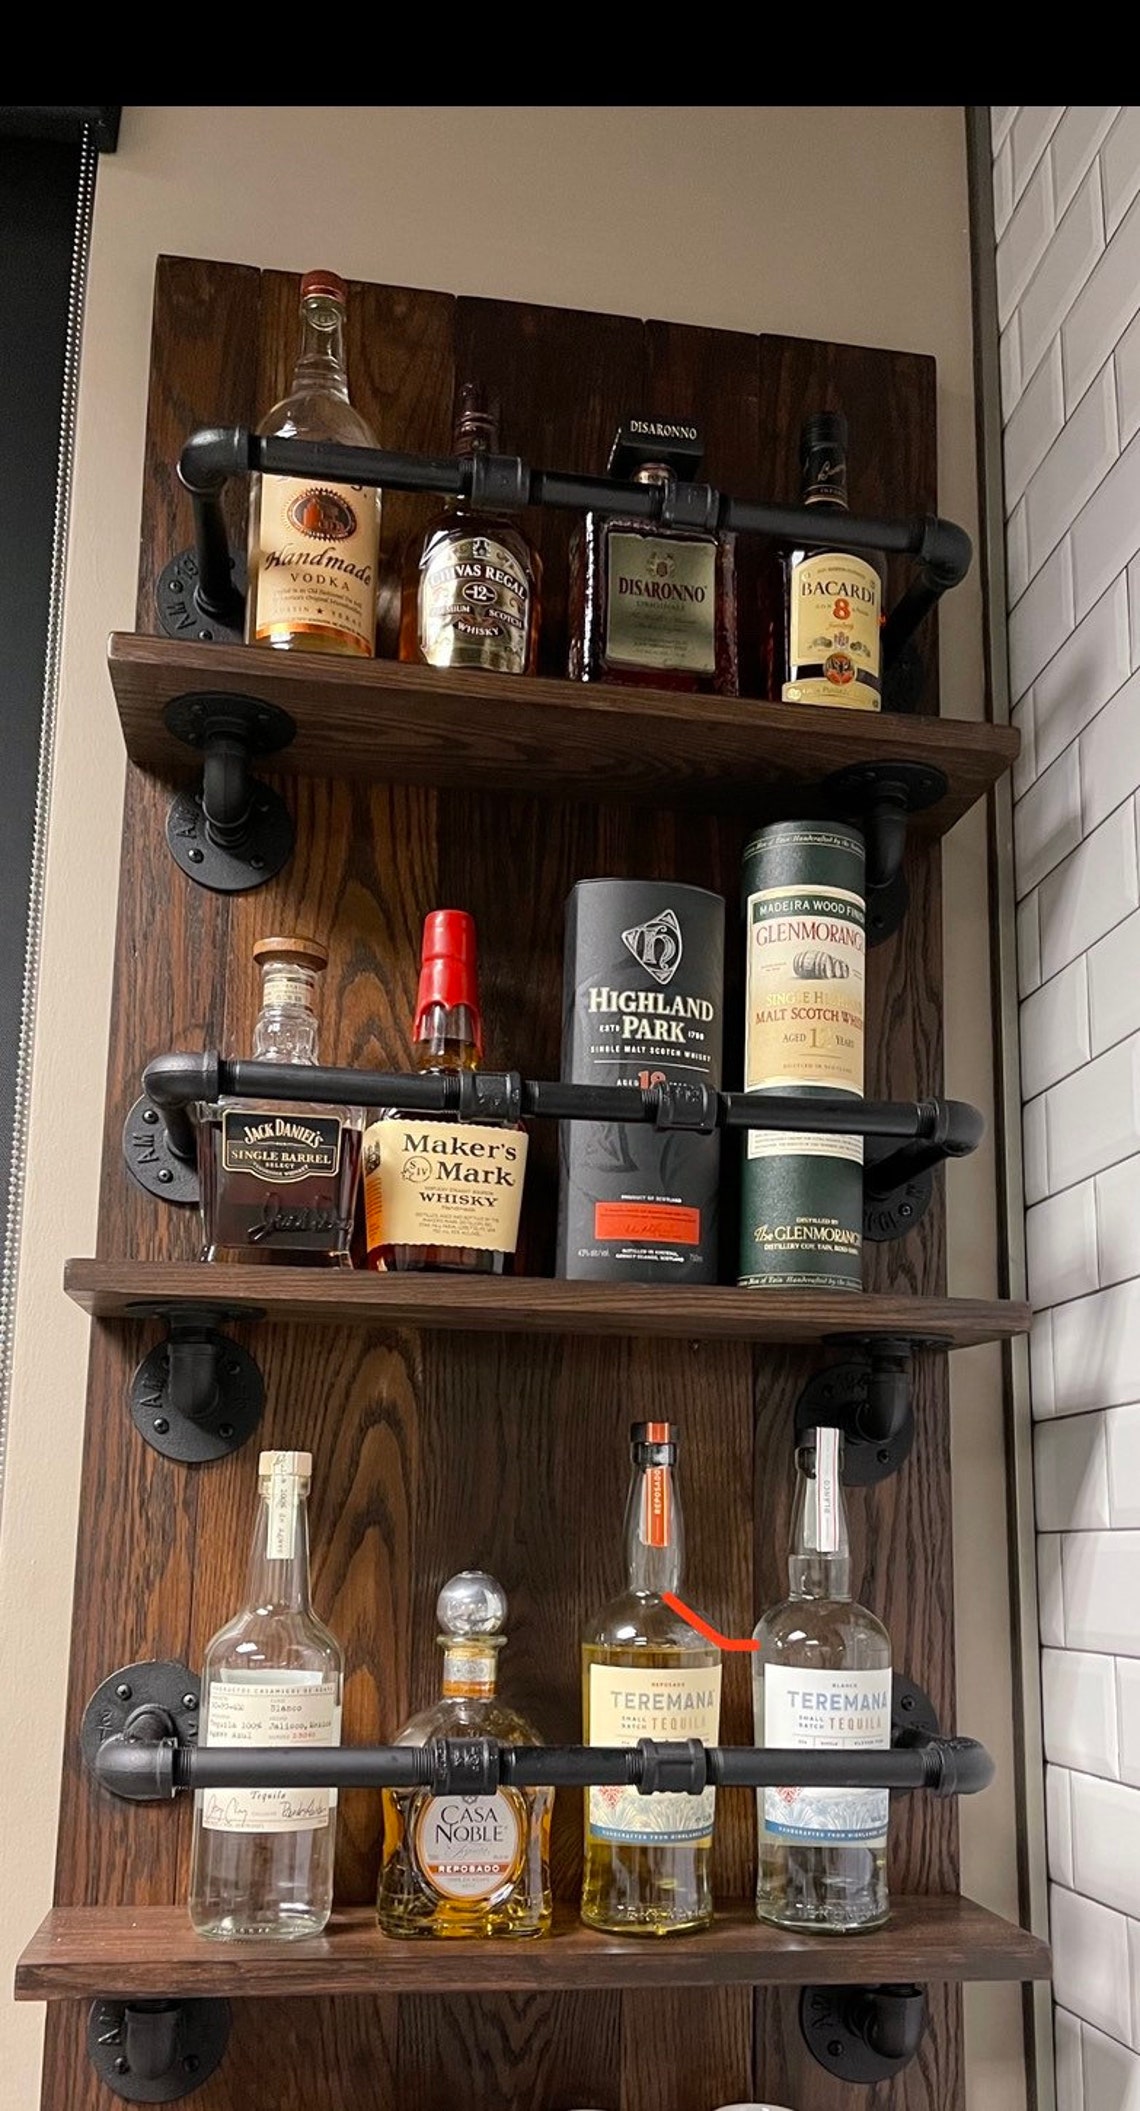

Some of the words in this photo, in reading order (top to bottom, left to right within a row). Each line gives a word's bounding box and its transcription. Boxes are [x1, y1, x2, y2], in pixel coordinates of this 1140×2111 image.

[630, 420, 697, 440] DISARONNO
[265, 543, 371, 585] Handmade
[290, 573, 351, 591] VODKA
[485, 566, 525, 599] REGAL
[619, 577, 706, 603] DISARONNO
[472, 585, 487, 600] 12
[802, 581, 875, 605] BACARDI
[833, 598, 851, 620] 8
[489, 609, 522, 629] SCOTCH
[458, 621, 499, 636] WHISKY
[760, 900, 810, 915] MADEIRA
[813, 901, 845, 913] WOOD
[588, 987, 714, 1022] HIGHLAND
[756, 1009, 787, 1024] MALT
[791, 1007, 839, 1022] SCOTCH
[622, 1015, 686, 1043] PARK
[782, 1033, 807, 1043] AGED
[624, 1045, 646, 1053] MALT
[650, 1047, 680, 1057] SCOTCH
[243, 1122, 275, 1144] JACK
[275, 1118, 324, 1148] DANIEL'S
[231, 1149, 279, 1161] SINGLE
[281, 1152, 332, 1164] BARREL
[402, 1134, 517, 1161] Maker's
[265, 1161, 295, 1169] SELECT
[435, 1161, 515, 1187] Mark
[419, 1192, 499, 1208] WHISKY
[796, 1217, 830, 1225] DISTILLED
[754, 1223, 774, 1242] The
[610, 1690, 714, 1711] TEREMANA
[787, 1690, 888, 1711] TEREMANA
[622, 1715, 646, 1723] SMALL
[651, 1715, 707, 1731] TEQUILA
[799, 1714, 824, 1723] SMALL
[799, 1722, 824, 1730] BATCH
[829, 1715, 882, 1731] TEQUILA
[440, 1805, 498, 1825] CASA
[435, 1823, 503, 1844] NOBLE
[438, 1865, 500, 1874] REPOSADO
